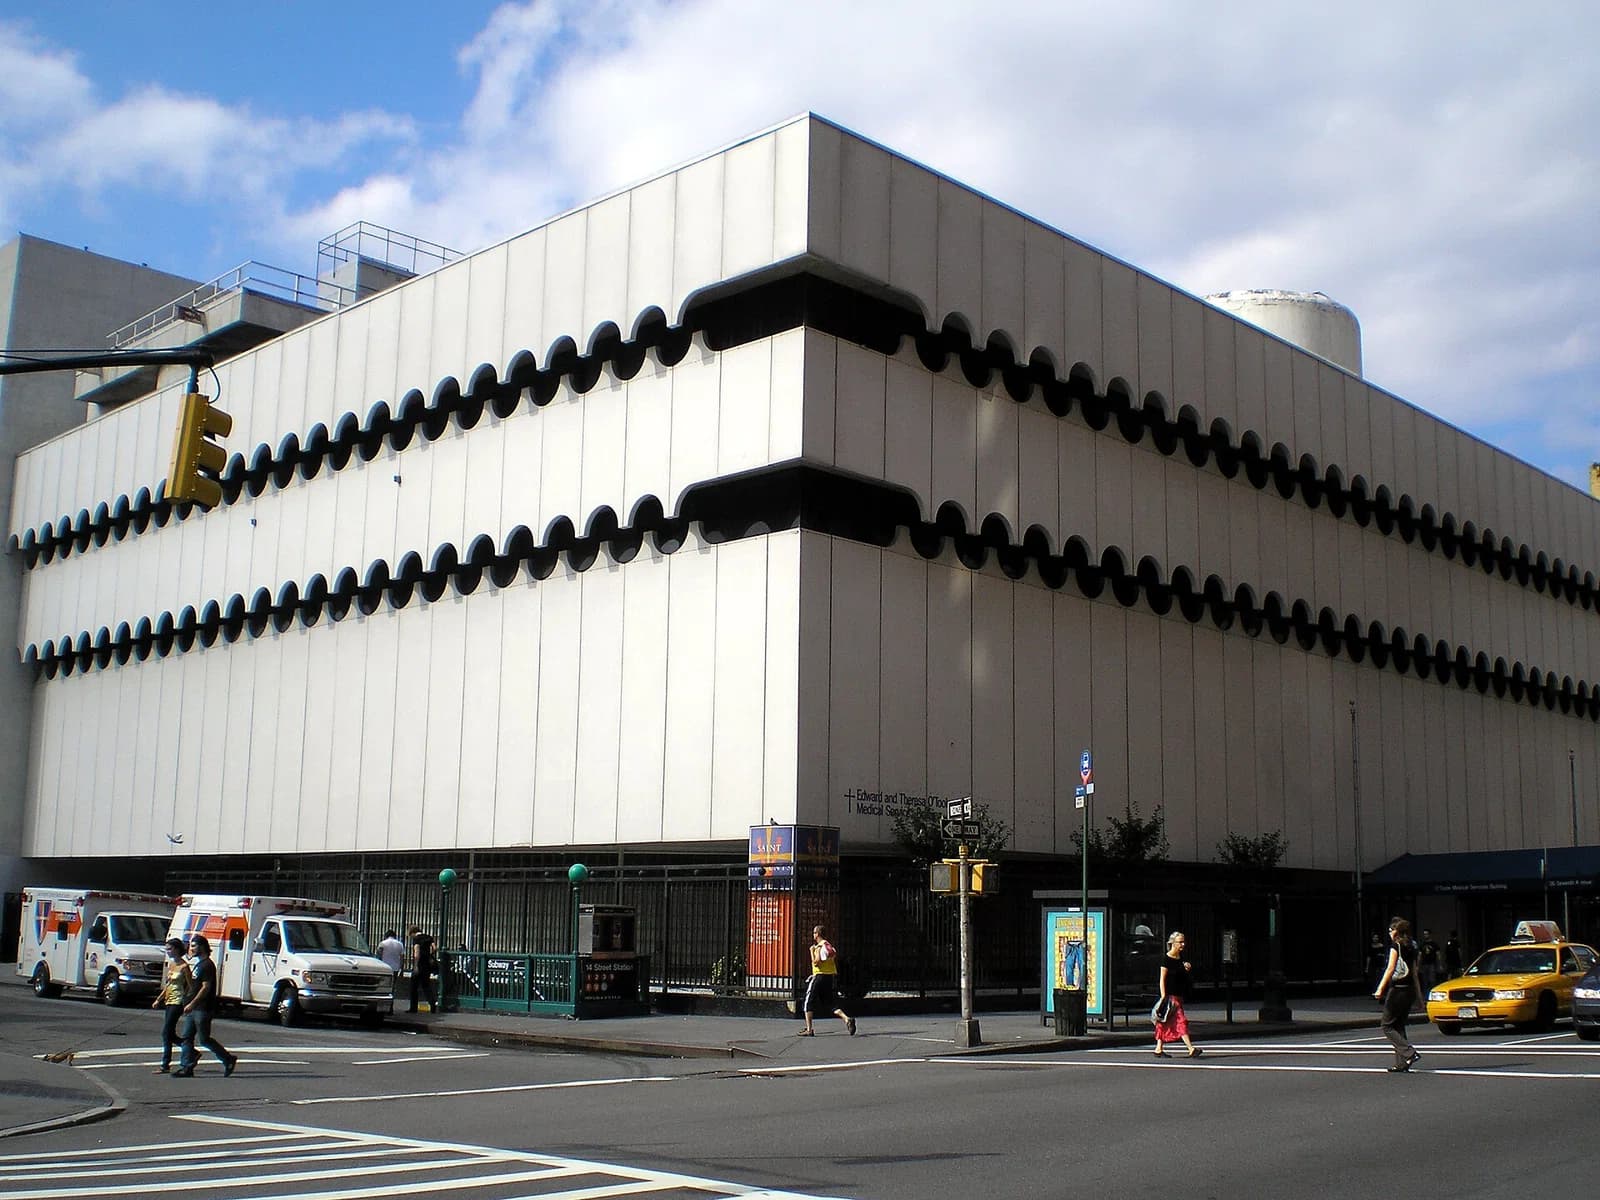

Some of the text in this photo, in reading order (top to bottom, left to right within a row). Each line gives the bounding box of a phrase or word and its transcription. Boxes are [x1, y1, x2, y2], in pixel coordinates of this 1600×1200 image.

[857, 789, 882, 803] Edward
[885, 793, 898, 804] and
[899, 793, 926, 807] Theresa
[857, 803, 883, 816] Medical
[758, 844, 782, 853] SAINT
[488, 959, 509, 971] Subway
[593, 962, 612, 972] Street
